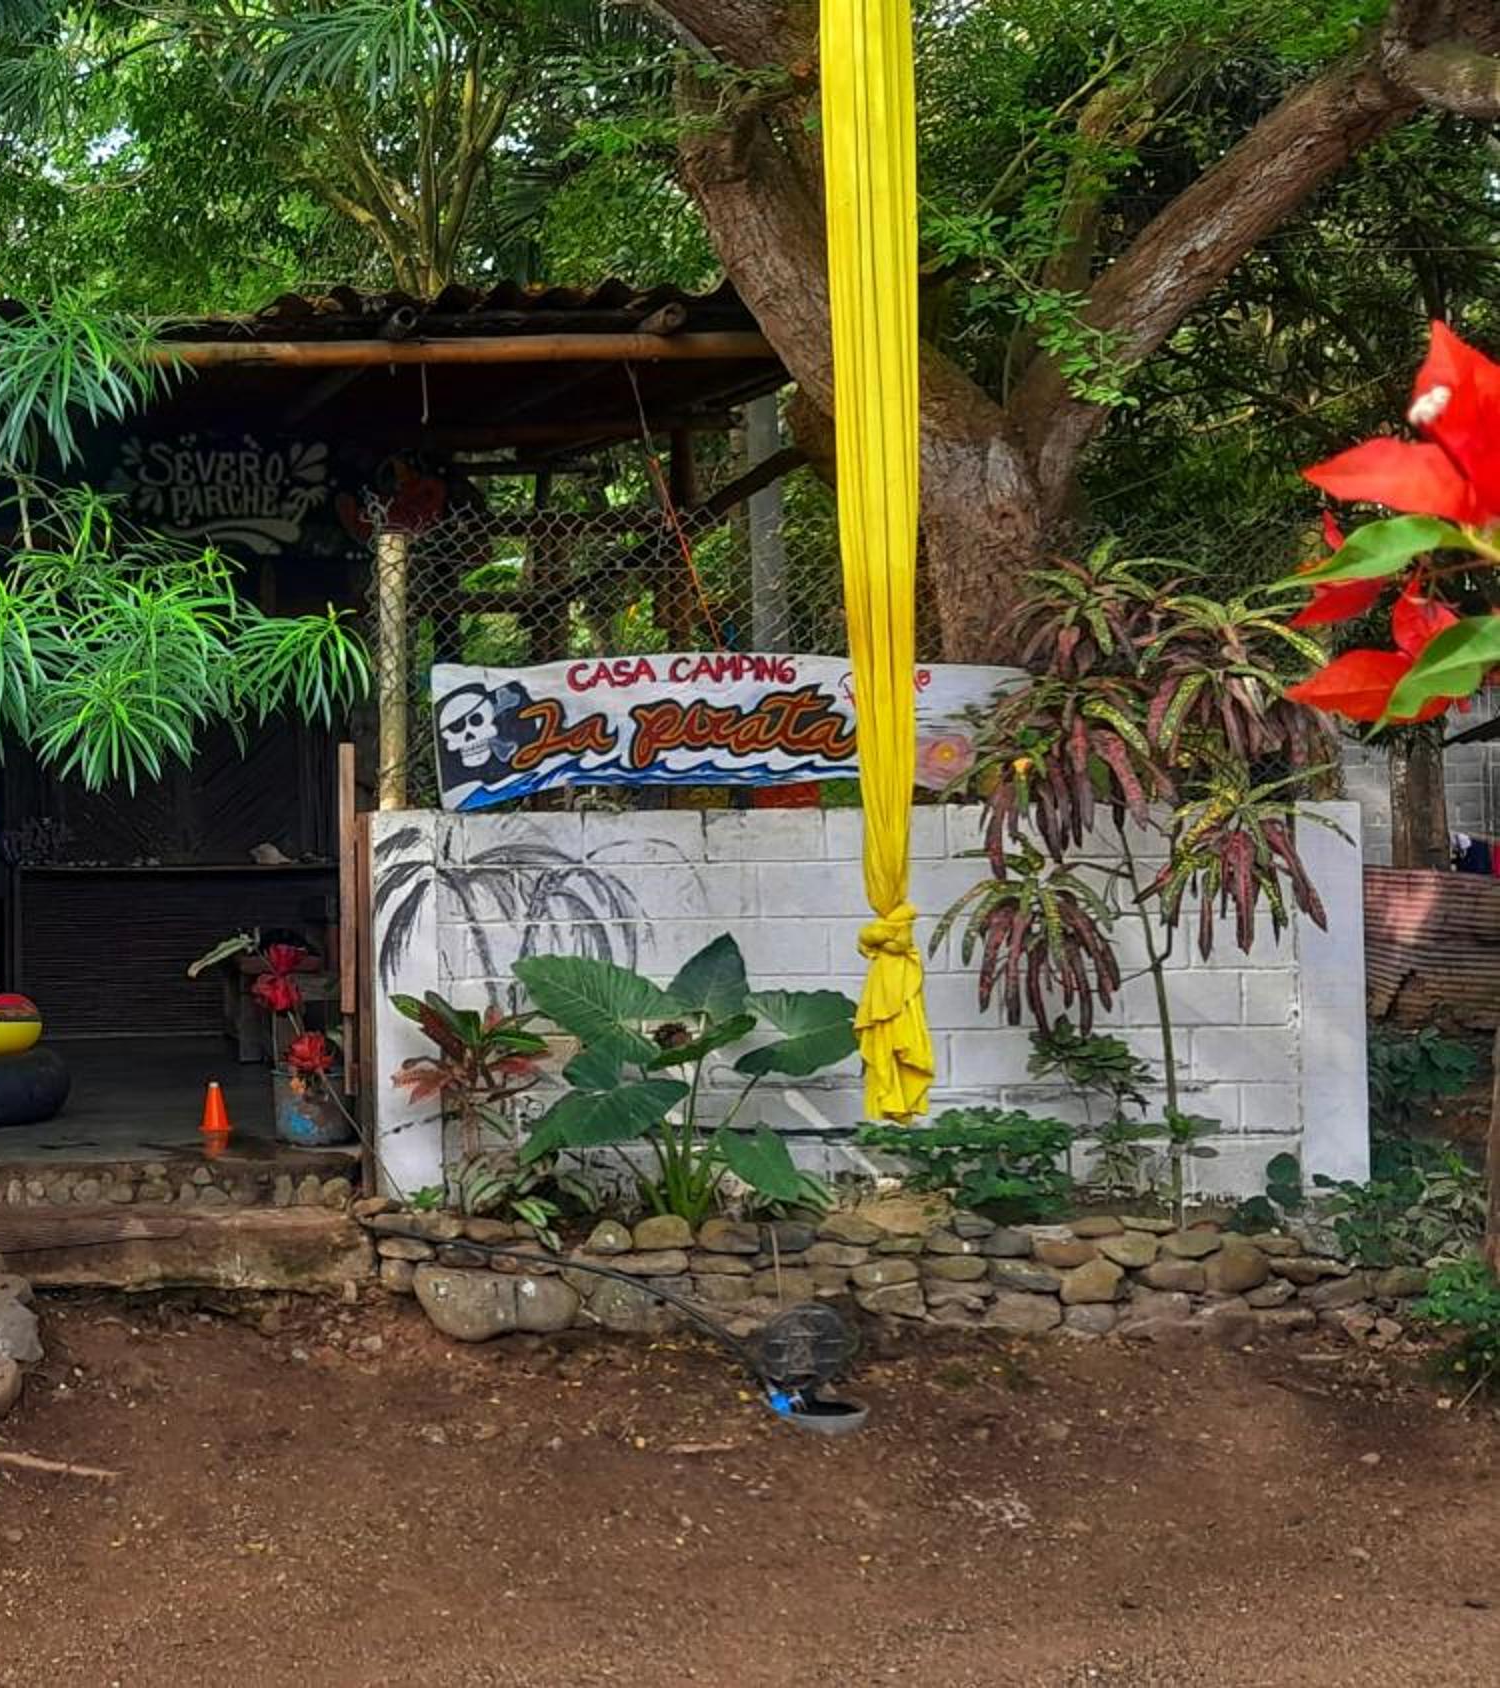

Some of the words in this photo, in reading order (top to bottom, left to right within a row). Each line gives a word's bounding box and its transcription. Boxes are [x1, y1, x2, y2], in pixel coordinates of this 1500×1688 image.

[137, 441, 285, 487] SEVERO
[169, 485, 280, 519] PARCHE
[567, 658, 656, 692] CASA
[668, 655, 797, 684] CAMPING
[509, 697, 619, 771] La
[630, 684, 857, 770] pirata
